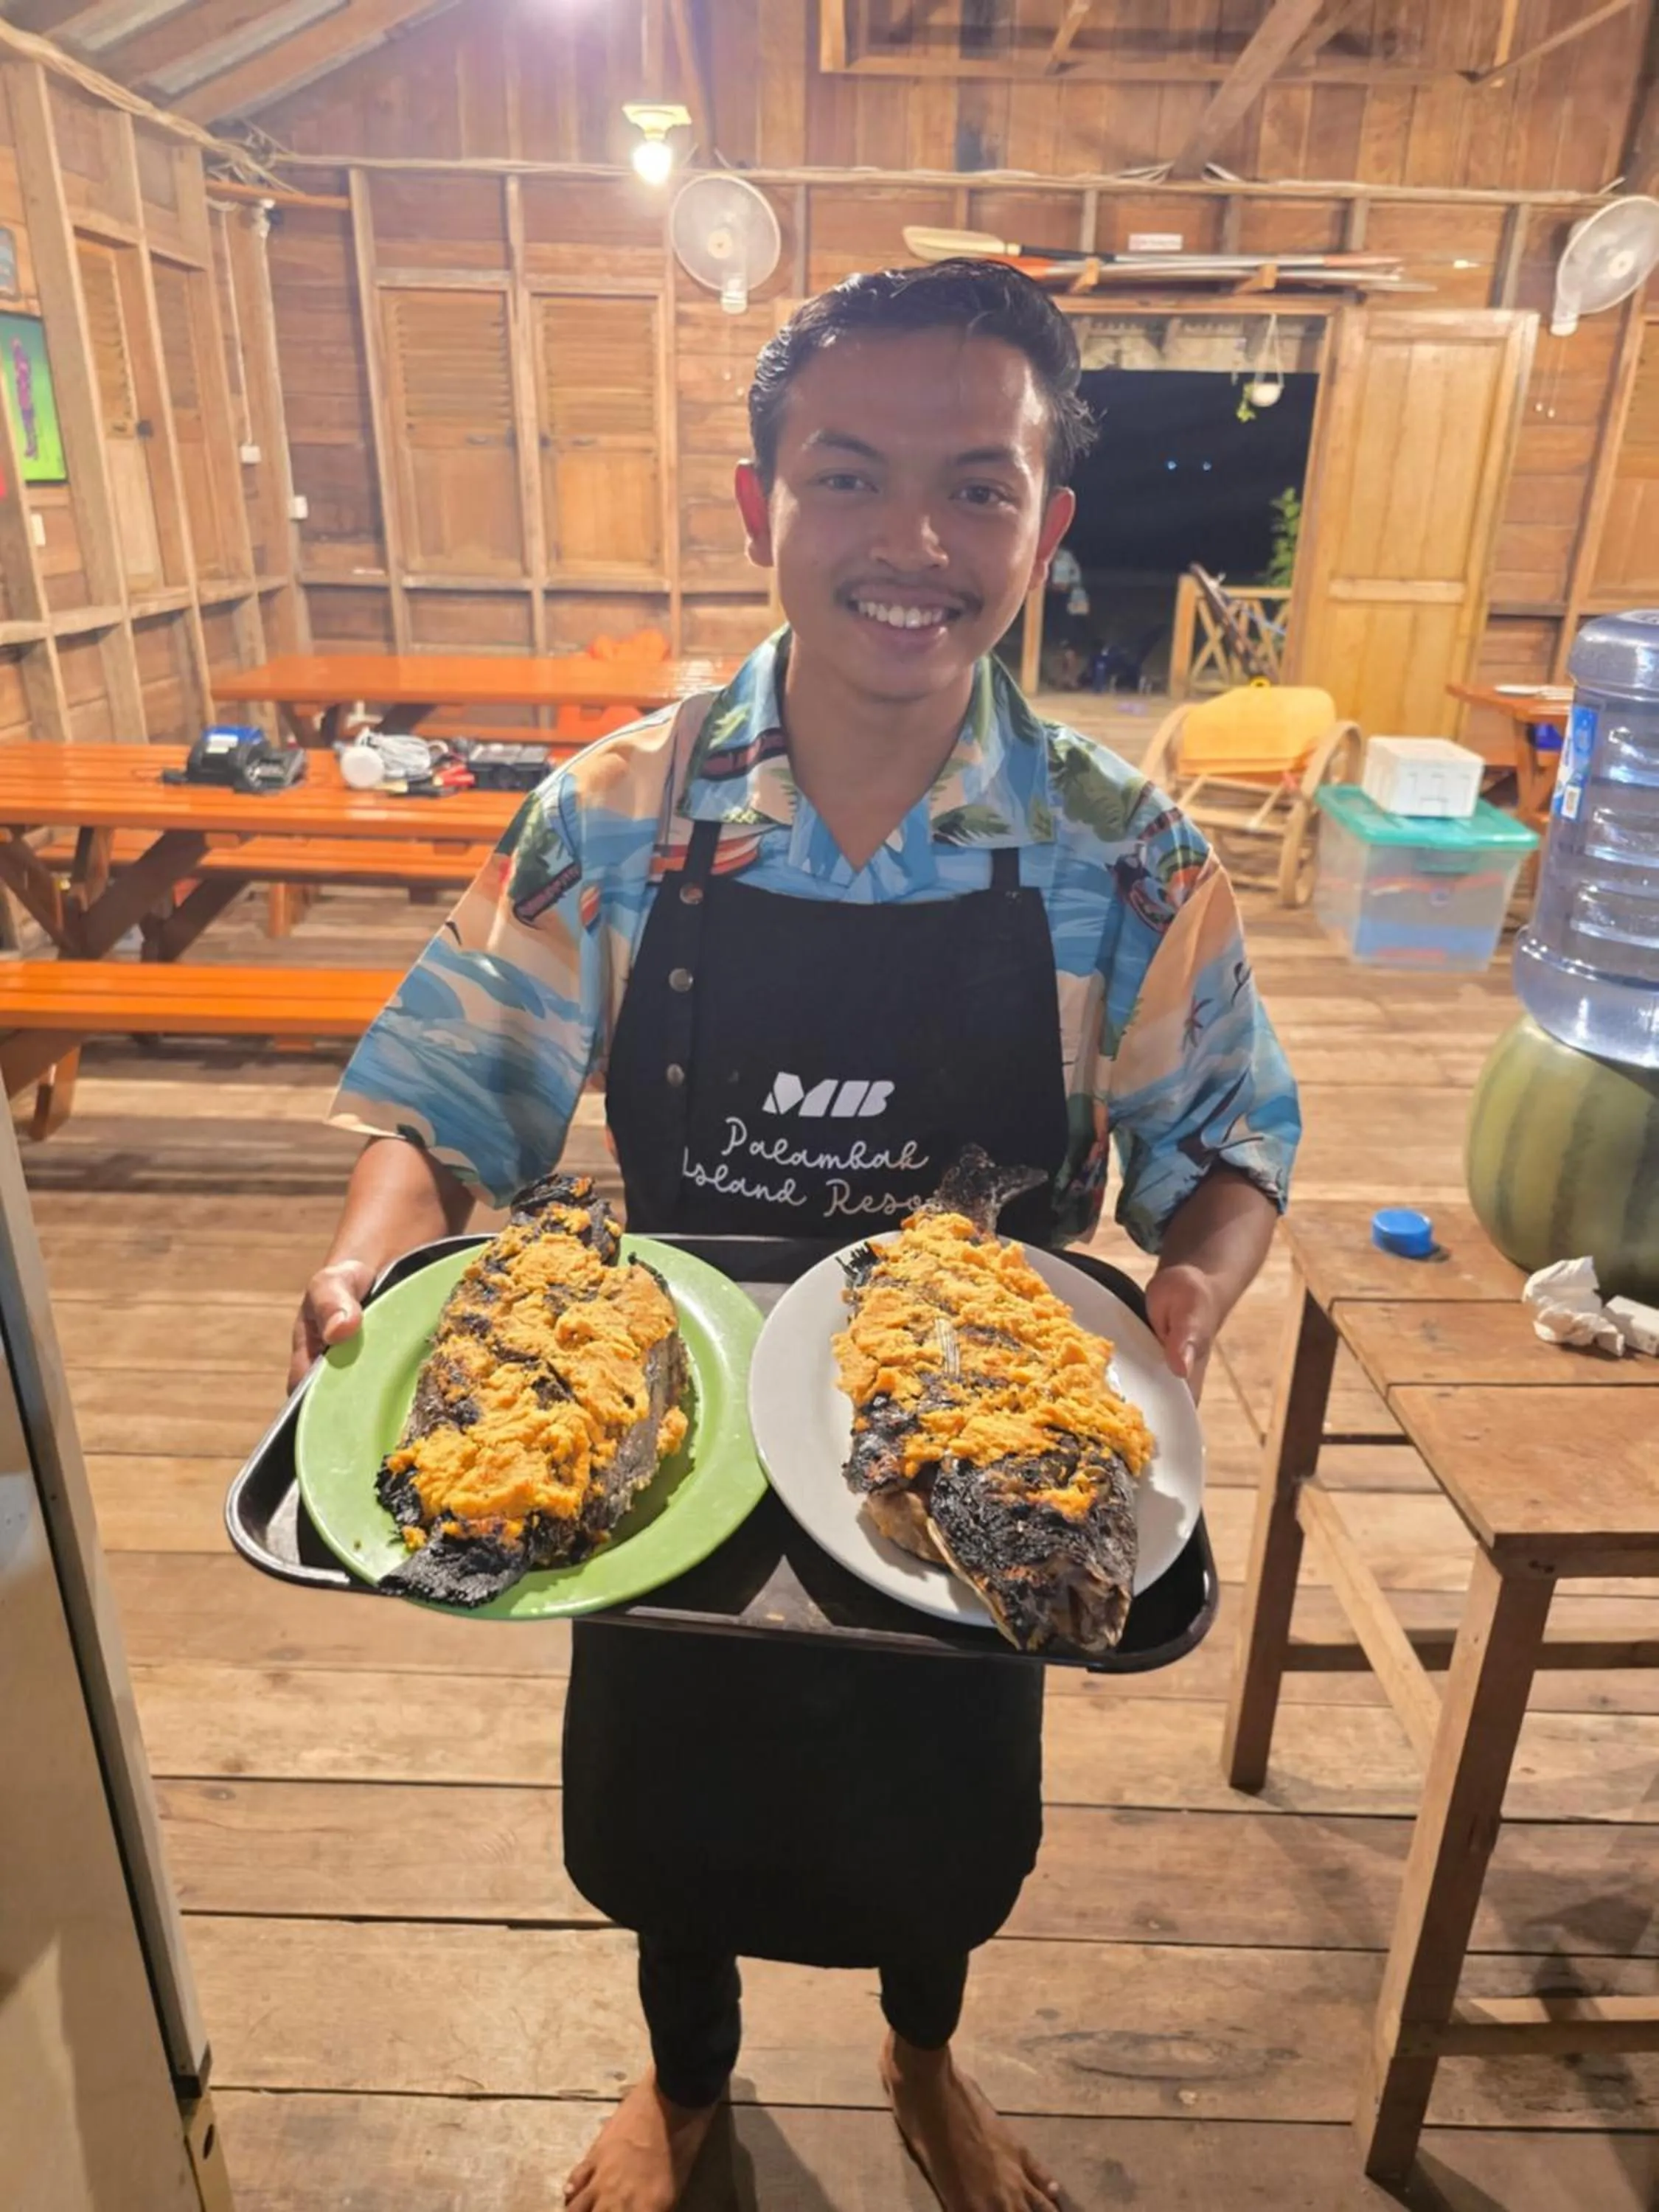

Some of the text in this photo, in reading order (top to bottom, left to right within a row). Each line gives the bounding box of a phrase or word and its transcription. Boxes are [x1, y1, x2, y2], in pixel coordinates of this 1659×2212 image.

[721, 1116, 930, 1170] Palambak
[681, 1146, 923, 1218] Island Reso
